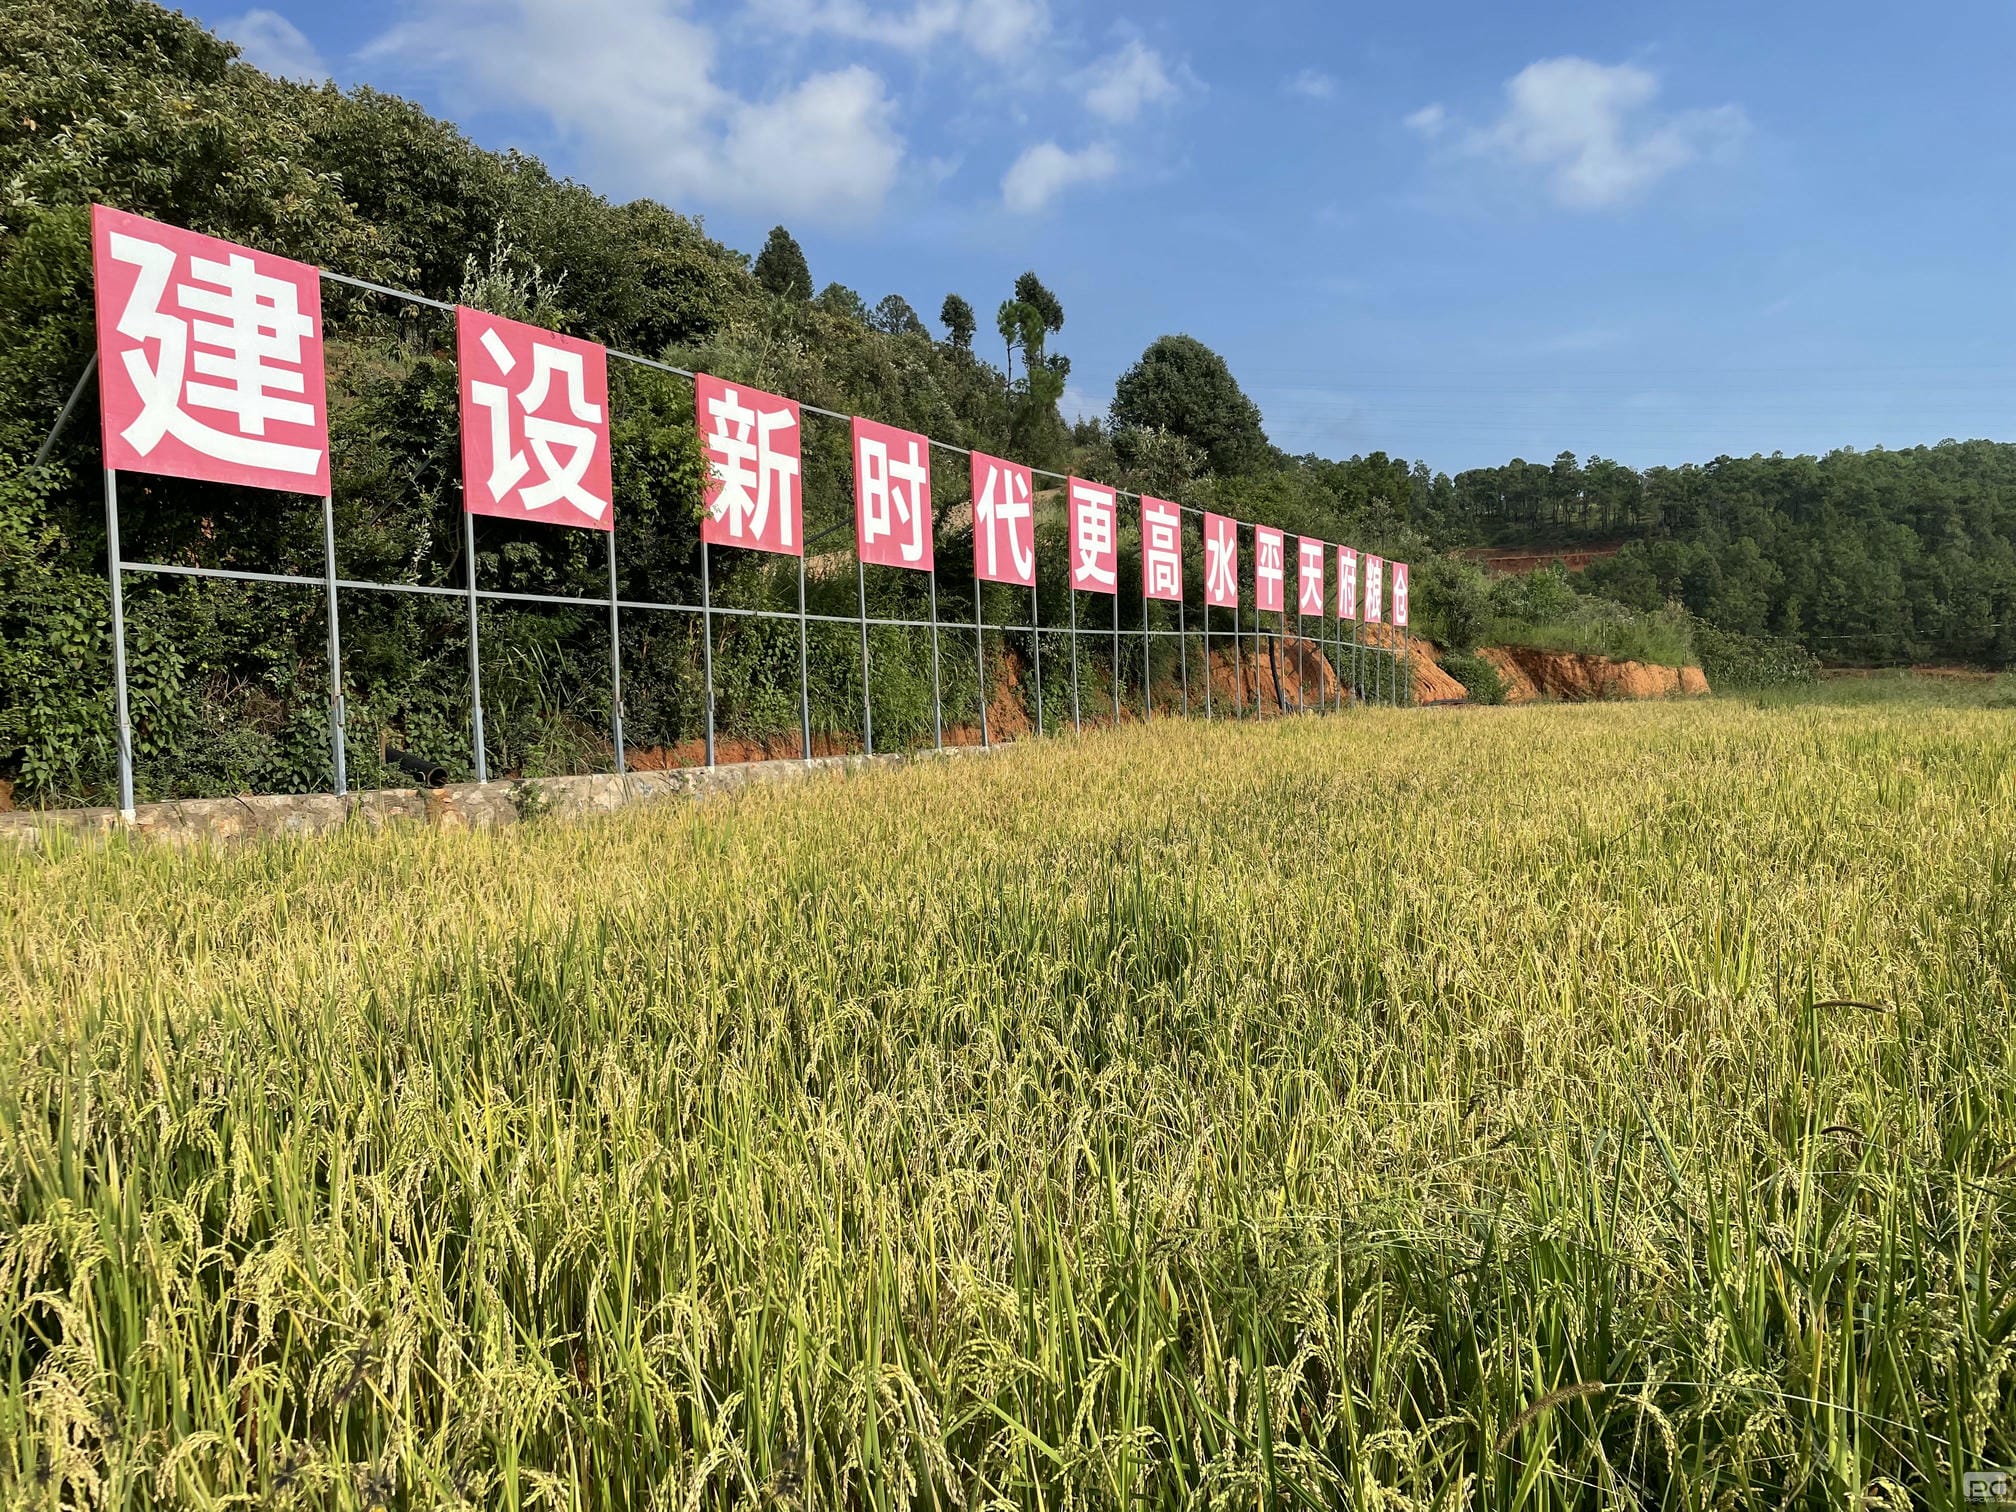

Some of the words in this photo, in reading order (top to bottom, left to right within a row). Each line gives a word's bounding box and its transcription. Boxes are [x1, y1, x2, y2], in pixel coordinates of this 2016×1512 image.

[109, 231, 1407, 623] 建设新时代更高水平天府粮仓
